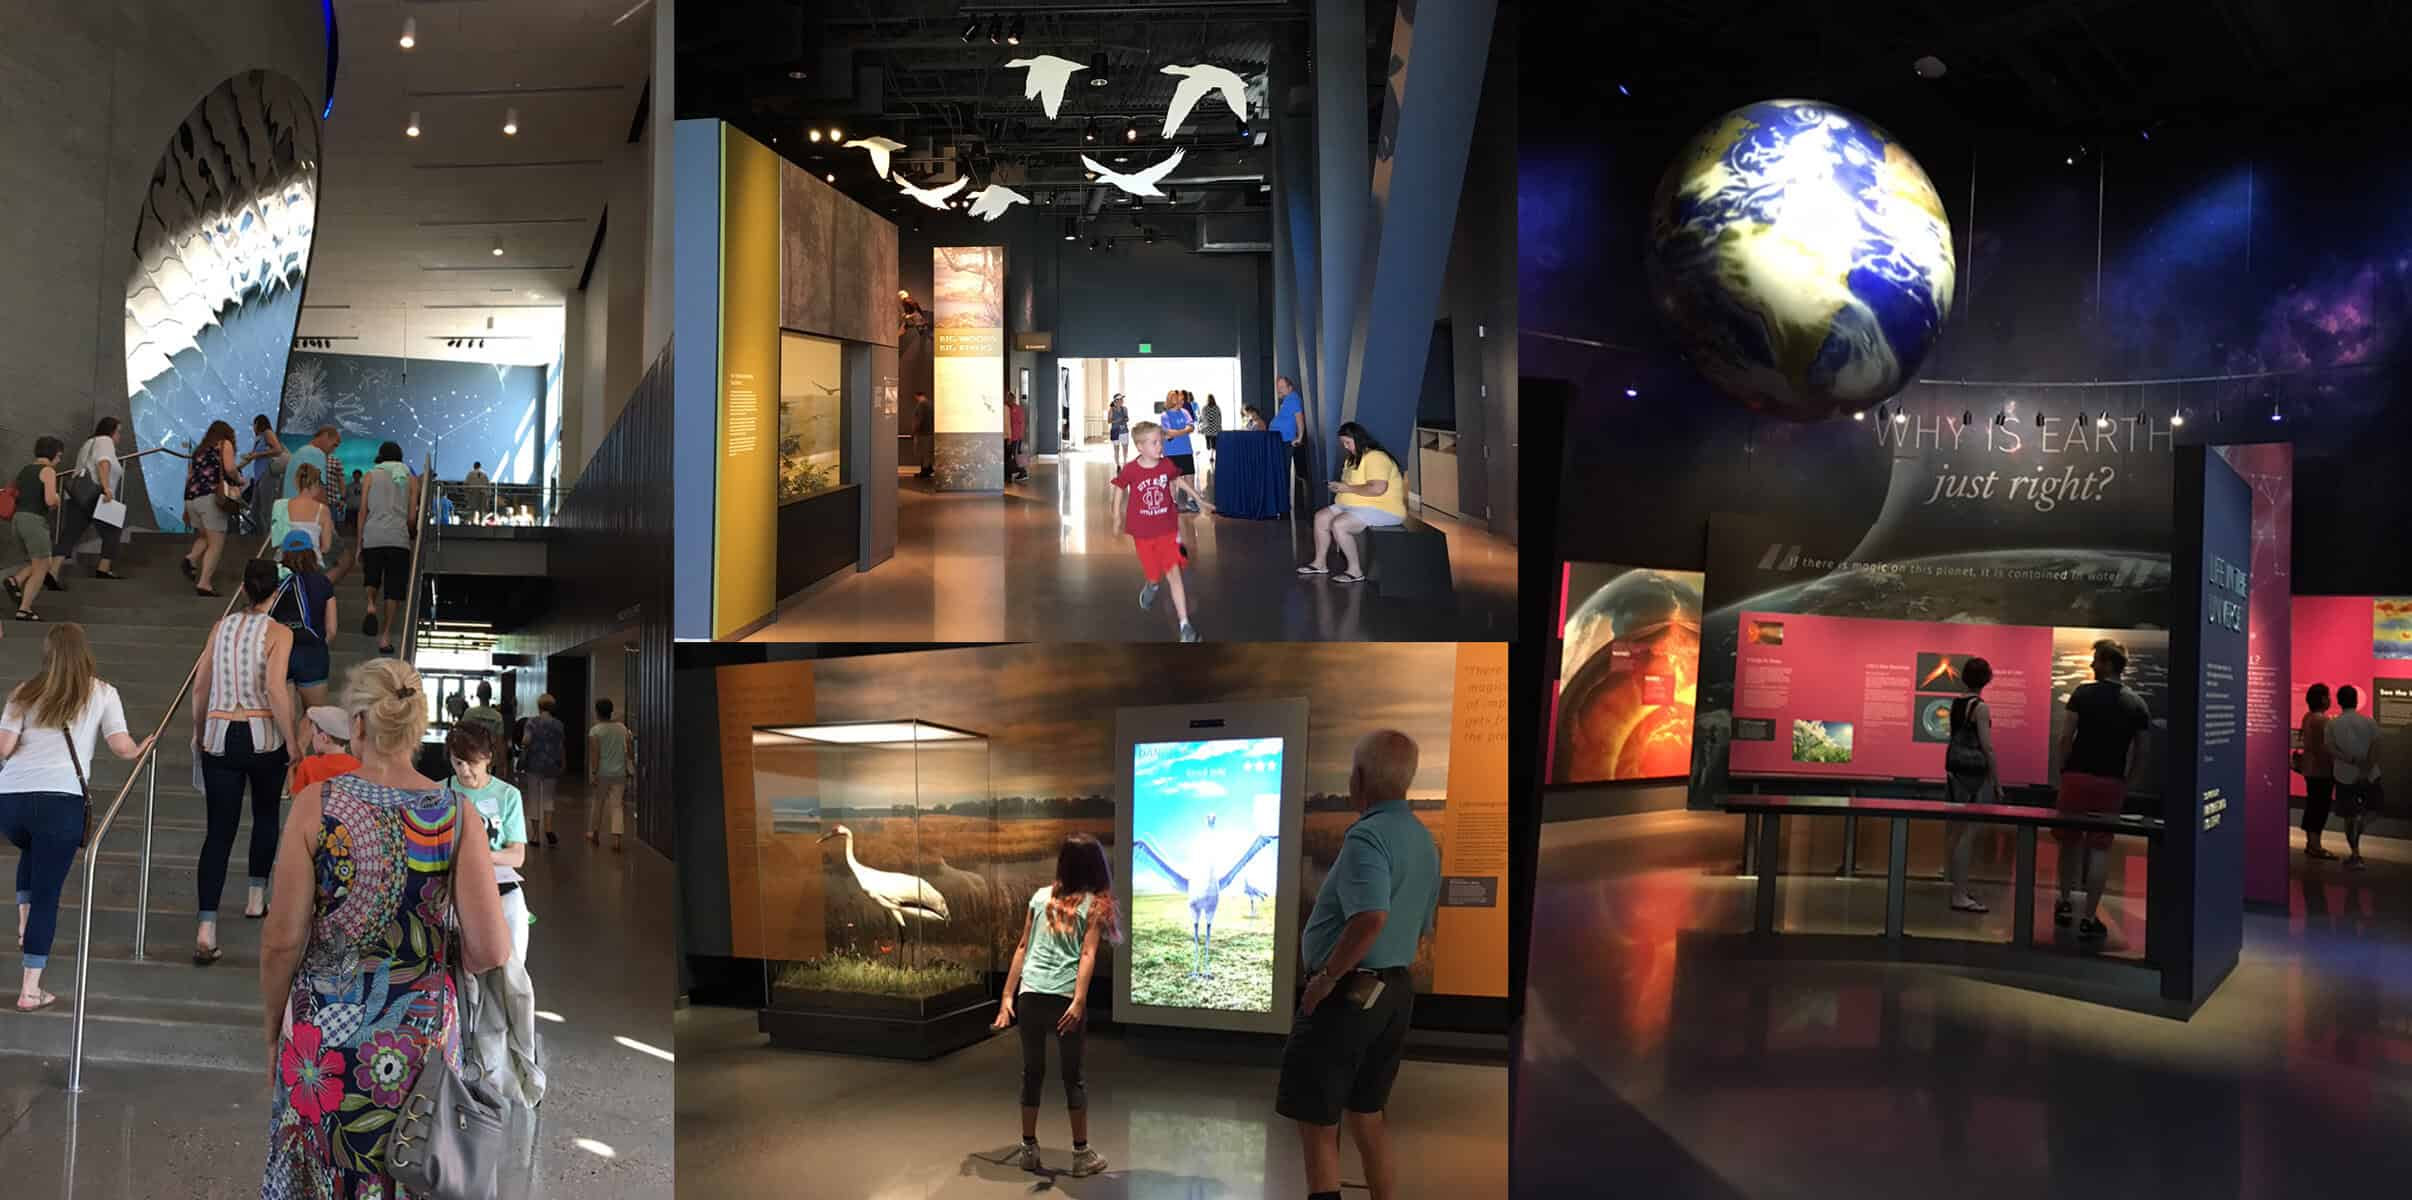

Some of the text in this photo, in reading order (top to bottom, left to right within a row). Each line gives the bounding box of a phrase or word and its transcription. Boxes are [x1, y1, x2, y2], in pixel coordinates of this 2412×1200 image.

[1873, 412, 2175, 453] WHY IS EARTH
[1923, 463, 2116, 512] just right?
[1801, 558, 1834, 569] there
[1852, 562, 1888, 577] magic
[1909, 564, 1933, 575] this
[2007, 568, 2069, 581] contained
